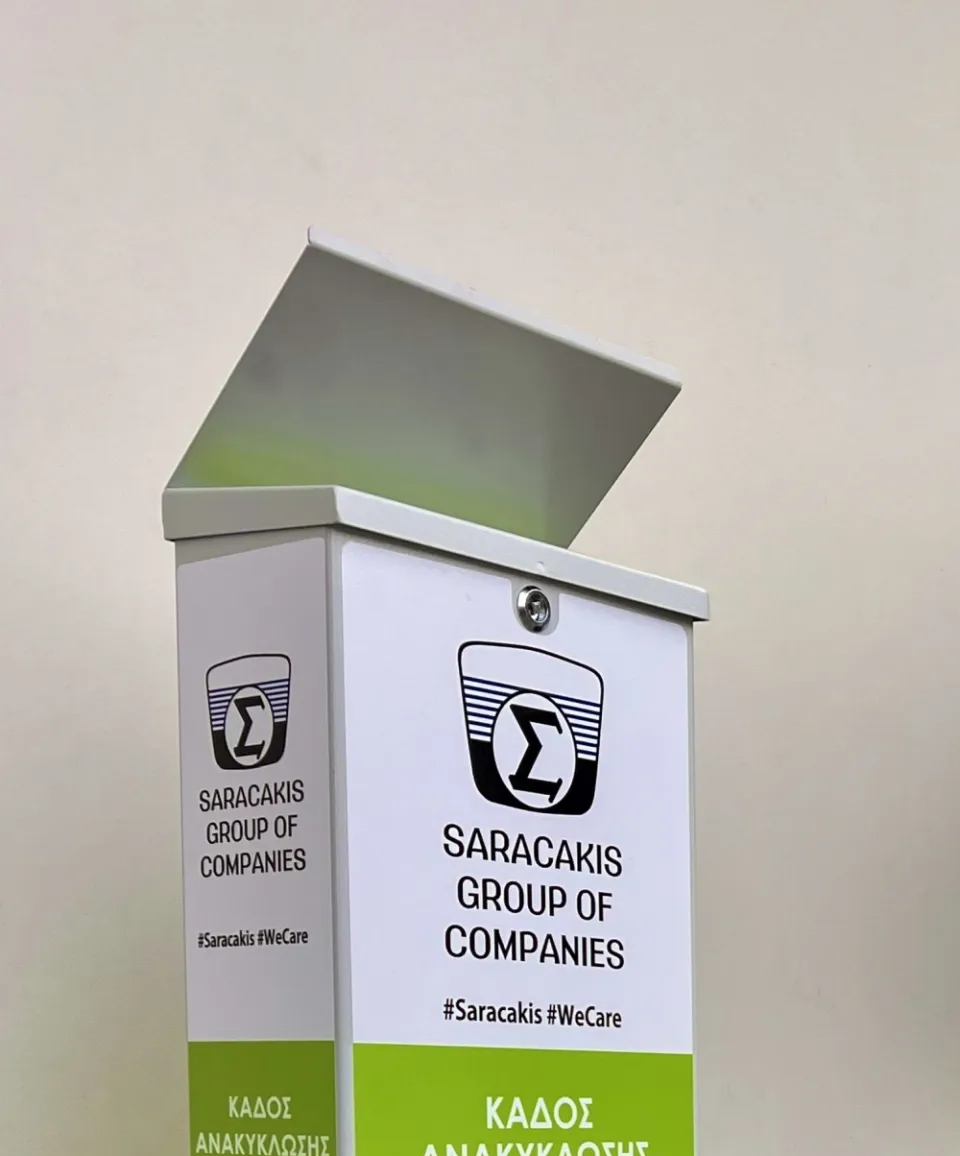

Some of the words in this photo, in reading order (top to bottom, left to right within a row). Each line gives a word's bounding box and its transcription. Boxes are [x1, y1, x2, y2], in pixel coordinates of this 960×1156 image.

[199, 779, 304, 812] SARACAKIS
[207, 818, 268, 844] GROUP
[275, 815, 297, 838] OF
[201, 848, 306, 877] COMPANIES
[444, 824, 622, 877] SARACAKIS
[458, 876, 566, 916] GROUP
[577, 890, 612, 921] OF
[198, 930, 255, 948] #Saracakis
[258, 928, 308, 945] #WeCare
[446, 925, 624, 969] COMPANIES
[444, 999, 542, 1024] #Saracakis
[547, 1005, 621, 1027] #WeCare
[229, 1096, 291, 1119] ΚΑΔΟΣ
[487, 1097, 592, 1129] ΚΑΔΟΣ
[196, 1133, 329, 1156] ΑΝΑΚΥΚΛΩΣΗΣ
